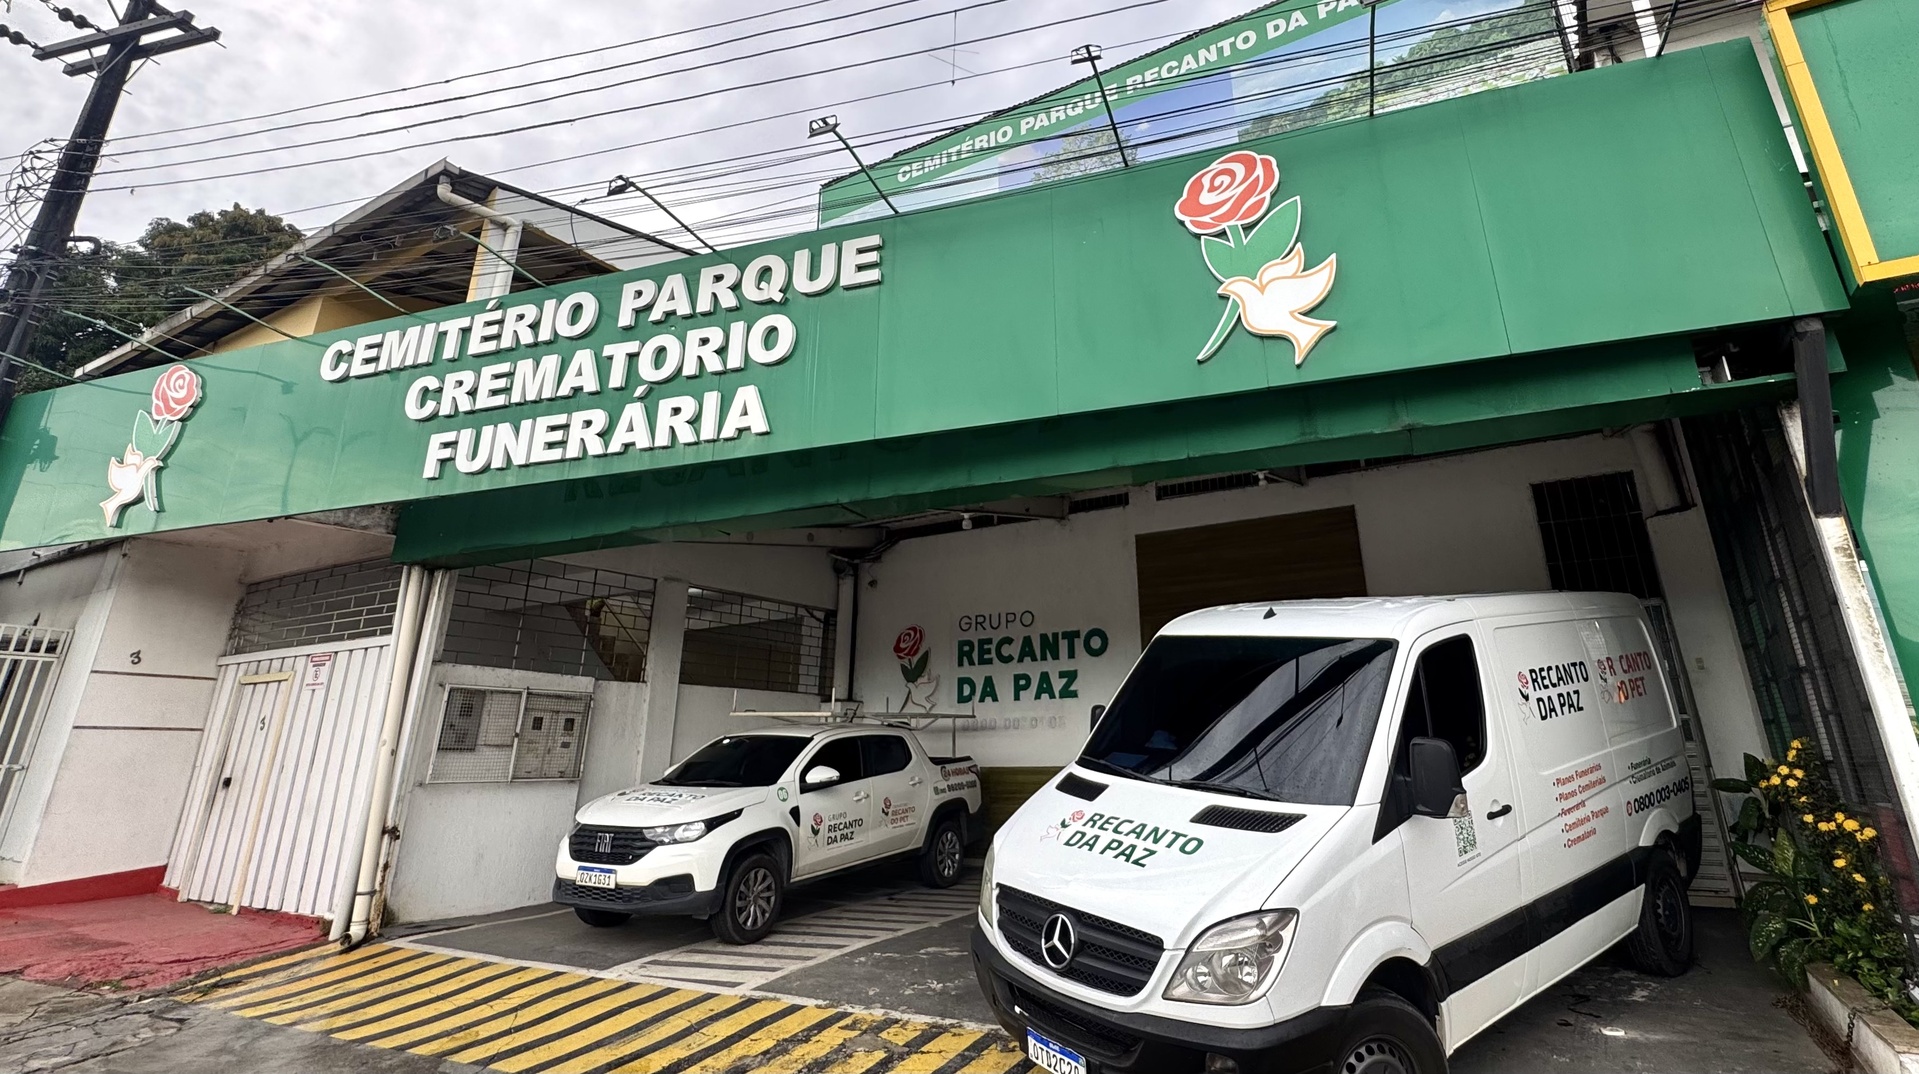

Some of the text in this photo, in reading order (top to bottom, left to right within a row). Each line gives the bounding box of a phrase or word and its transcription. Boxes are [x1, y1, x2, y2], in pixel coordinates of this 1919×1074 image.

[897, 0, 1359, 183] CEMITÉRIO PARQUE RECANTO DA PA
[320, 234, 883, 382] CEMITÉRIO PARQUE
[422, 384, 770, 480] FUNERÁRIA
[958, 610, 1035, 632] GRUPO
[129, 649, 142, 665] 3
[957, 628, 1109, 667] RECANTO
[1528, 661, 1589, 692] RECANTO
[1606, 651, 1652, 677] RCANTO
[957, 669, 1079, 704] DA PAZ
[1628, 676, 1647, 699] PET
[1536, 688, 1584, 721] DA PAZ
[1556, 773, 1575, 788] Planos
[827, 811, 848, 821] GRUPO
[1633, 792, 1655, 814] 0800
[826, 835, 838, 846] DA
[839, 831, 855, 843] PAZ
[827, 818, 864, 834] RECANTO
[1082, 812, 1204, 855] RECANTO
[595, 833, 614, 853] FIAT
[1063, 830, 1158, 868] DA PAZ
